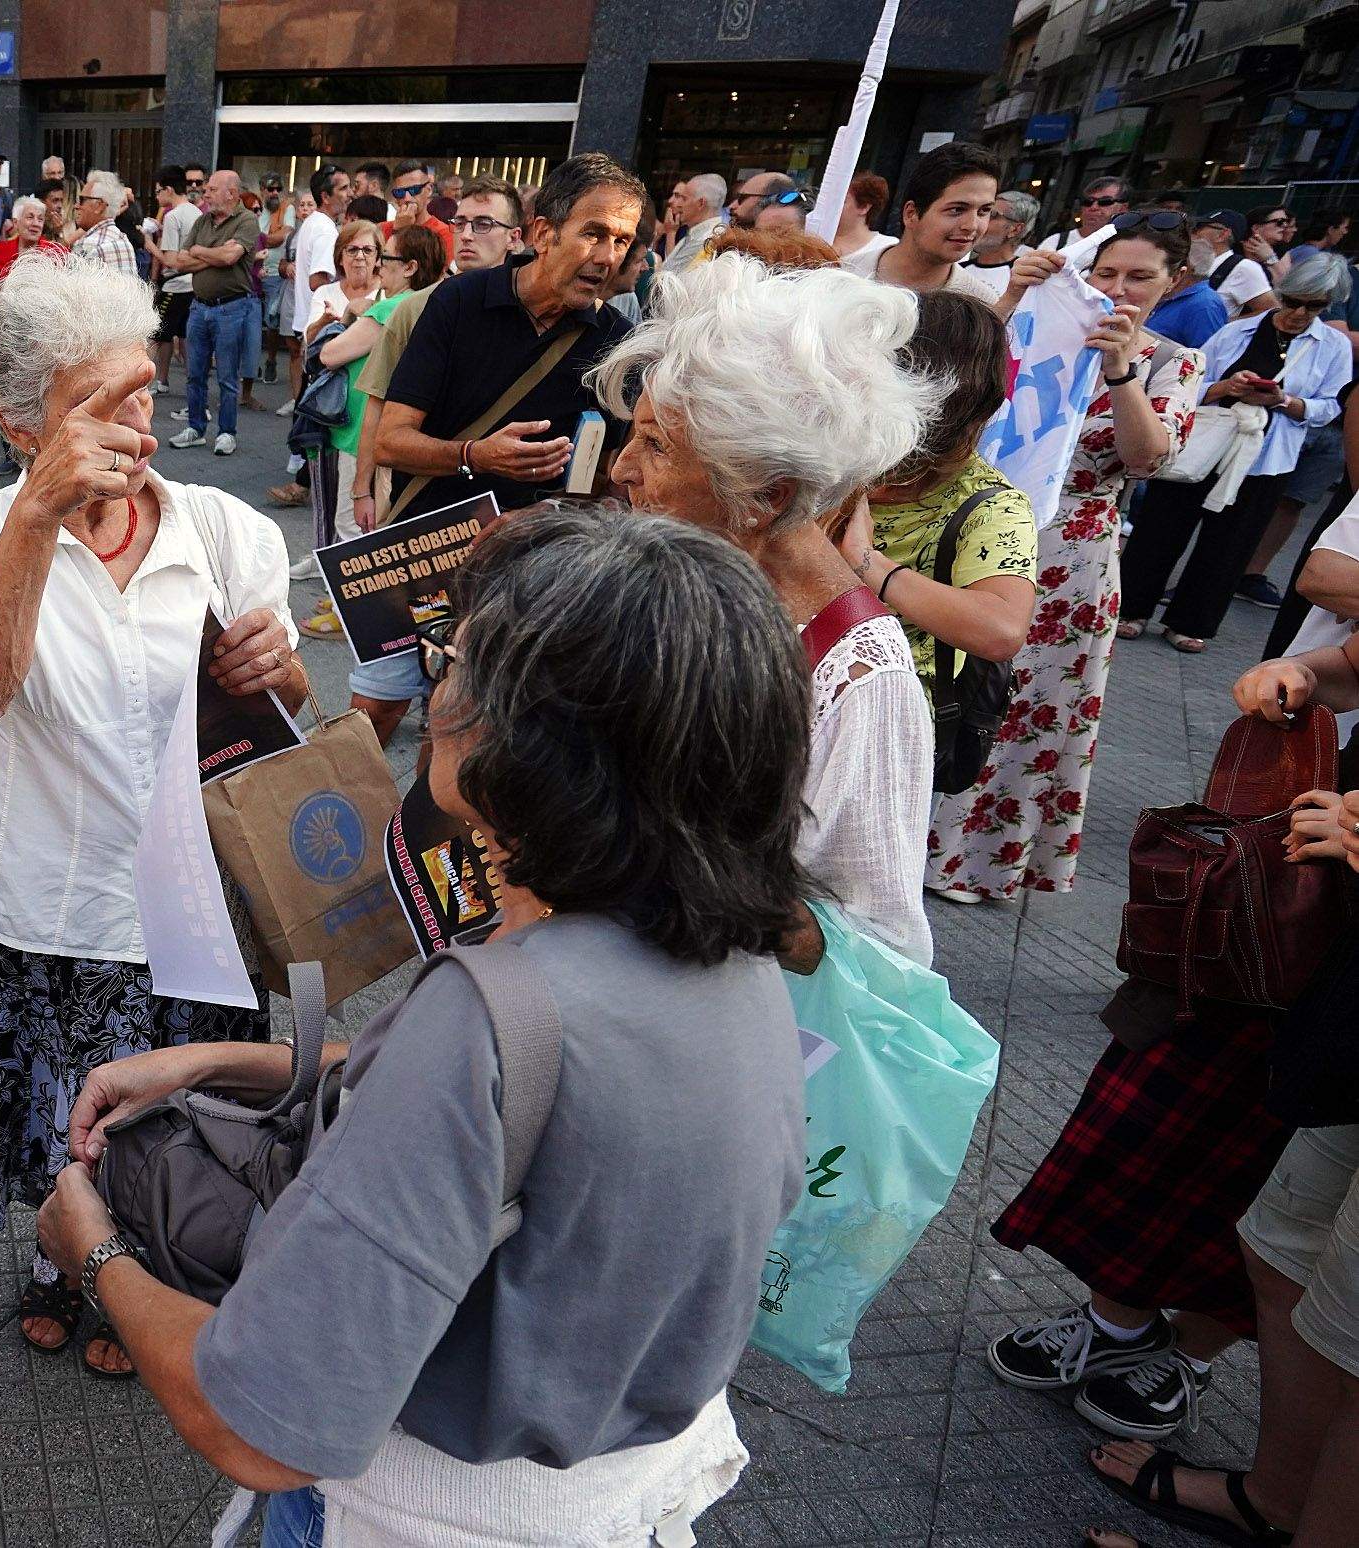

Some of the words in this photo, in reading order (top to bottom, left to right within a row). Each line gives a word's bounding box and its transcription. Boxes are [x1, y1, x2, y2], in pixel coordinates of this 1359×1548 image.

[339, 554, 373, 577] CON
[371, 542, 409, 567] ESTE
[407, 518, 482, 556] GOBERNO
[340, 566, 409, 600] ESTAMOS
[408, 559, 432, 580] NO
[201, 739, 253, 772] FUTURO
[393, 835, 419, 886] MONTE
[410, 883, 441, 939] GALEGO
[437, 848, 460, 885] NUNCA
